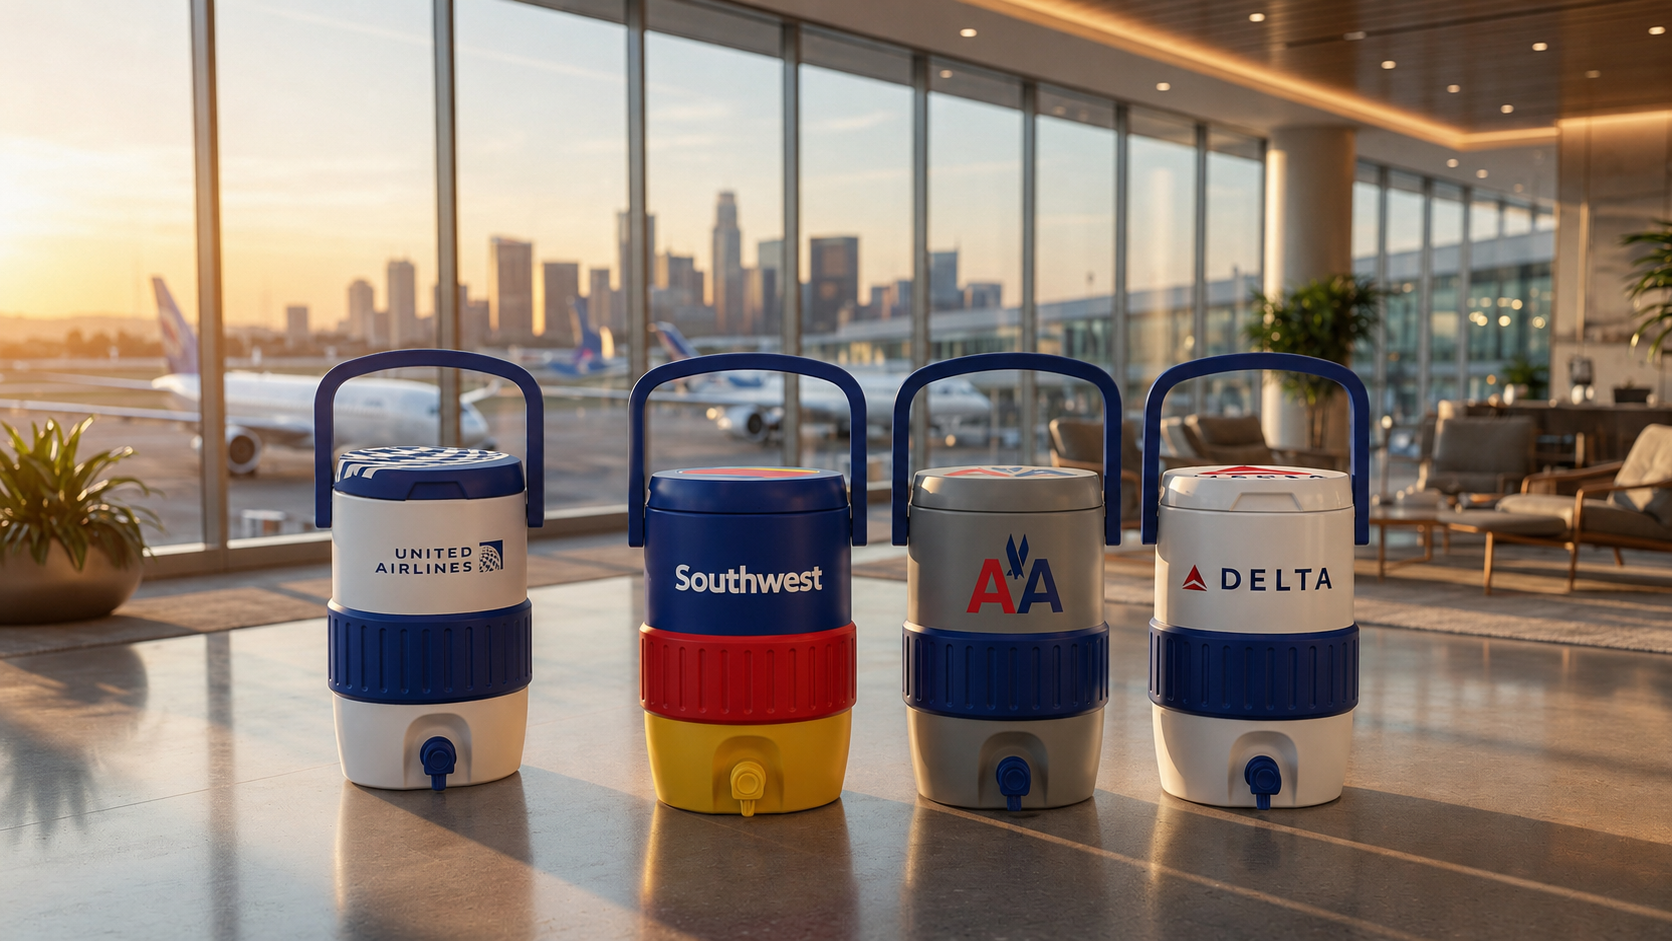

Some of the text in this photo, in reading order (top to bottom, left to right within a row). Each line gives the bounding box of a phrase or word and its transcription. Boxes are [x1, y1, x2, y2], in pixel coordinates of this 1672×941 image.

[395, 546, 472, 560] UNITED
[375, 561, 473, 575] AIRLINES
[675, 564, 823, 594] Southwest
[1221, 567, 1333, 592] DELTA
[966, 558, 1064, 614] AA
